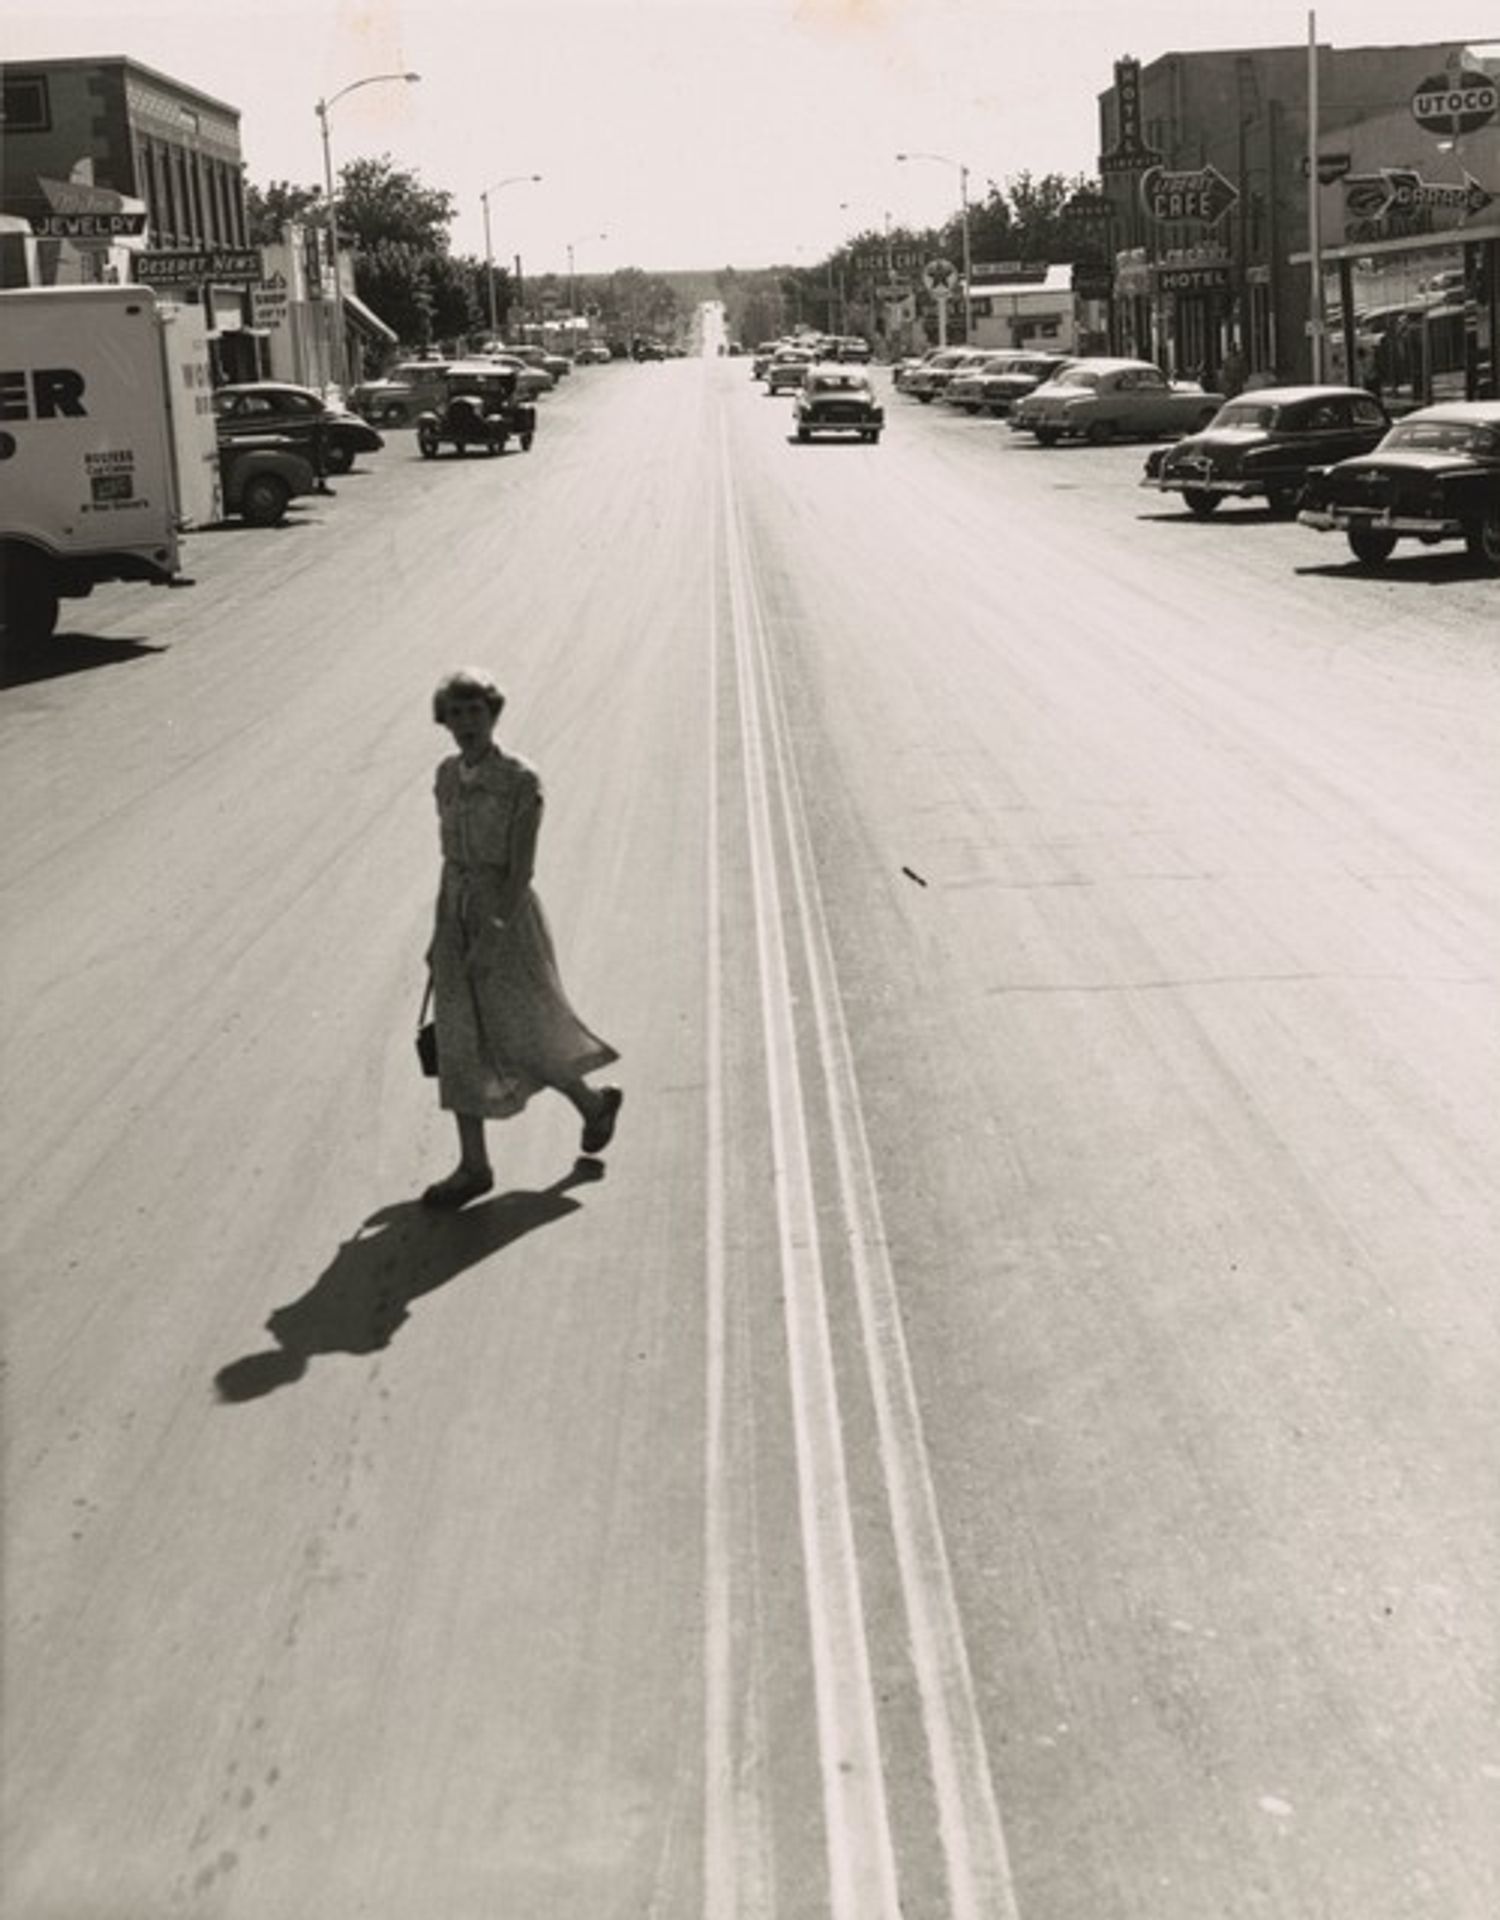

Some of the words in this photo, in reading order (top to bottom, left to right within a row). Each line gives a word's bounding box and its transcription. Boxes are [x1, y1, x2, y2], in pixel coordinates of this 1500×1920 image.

[1122, 69, 1136, 152] HOTEL
[1418, 90, 1493, 115] UTOCO
[1155, 192, 1210, 217] CAFE
[36, 215, 138, 235] JEWELRY
[1162, 271, 1226, 289] HOTEL
[0, 369, 88, 420] ER
